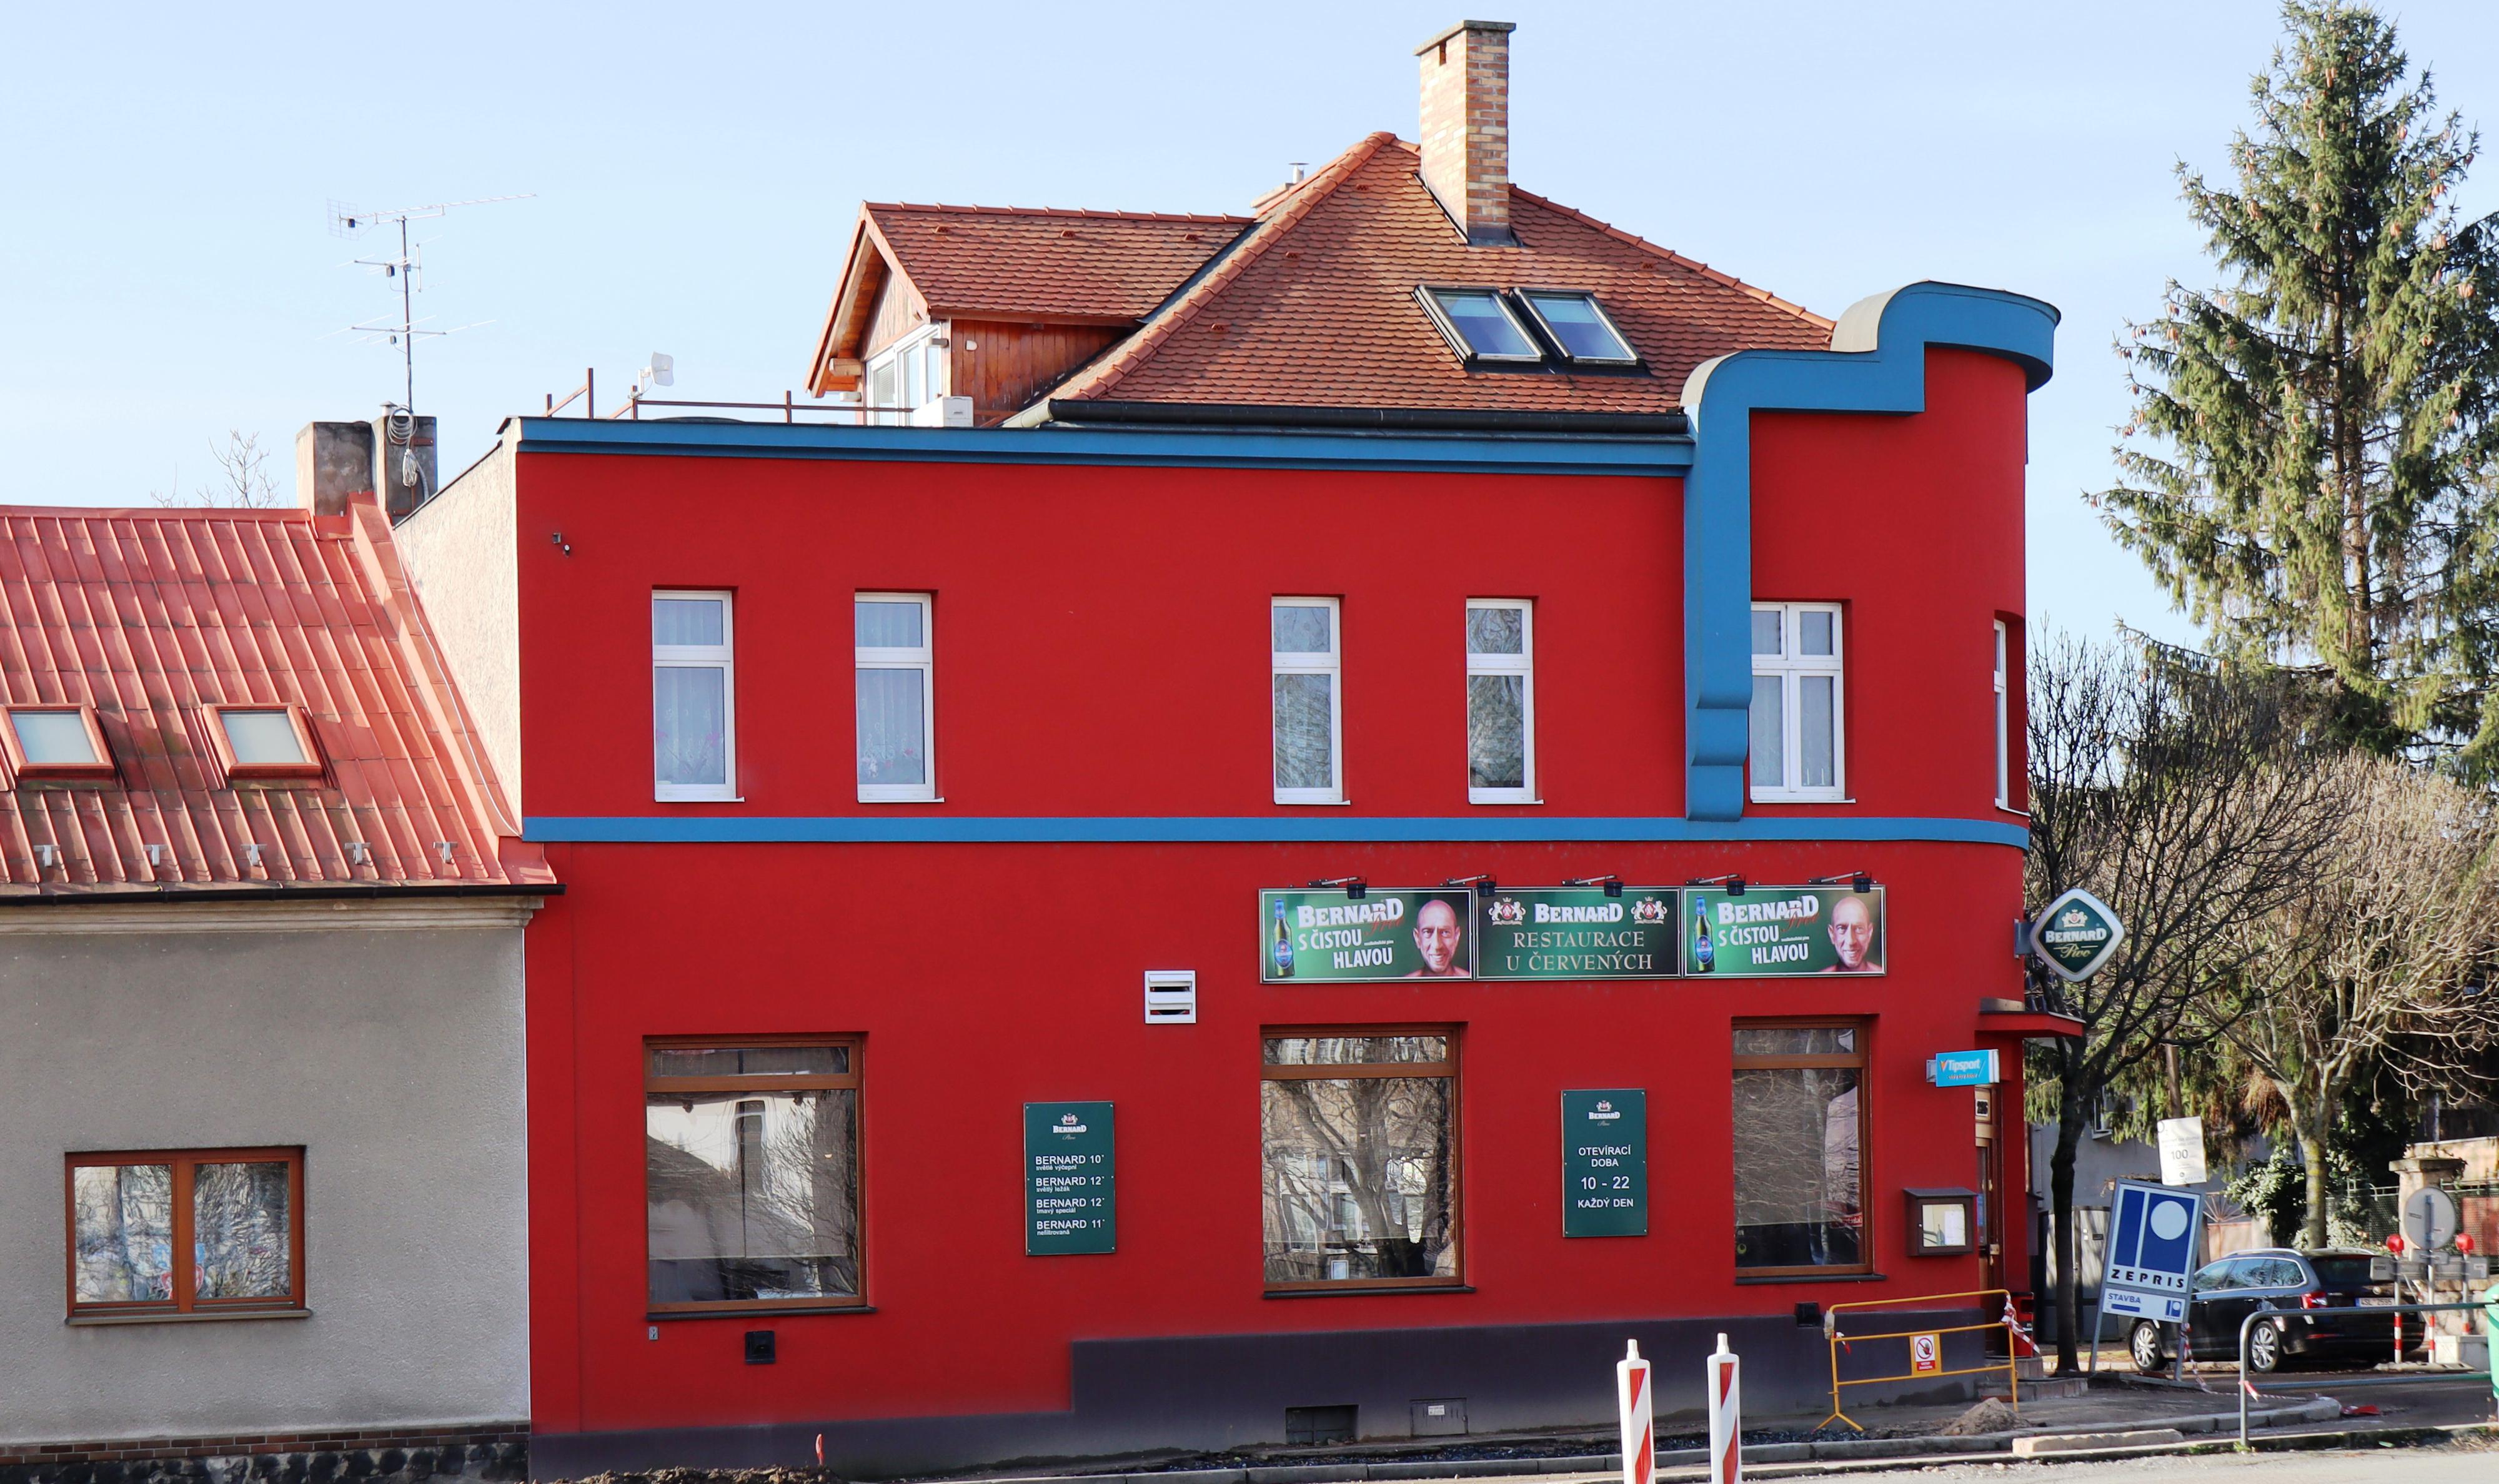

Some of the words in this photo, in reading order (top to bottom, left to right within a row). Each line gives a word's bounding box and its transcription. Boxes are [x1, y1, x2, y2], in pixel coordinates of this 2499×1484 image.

[1296, 898, 1404, 928] BERNARD
[1534, 903, 1624, 923] BERNARD
[1717, 895, 1819, 924] BERNARD
[1298, 933, 1308, 951] S
[1310, 929, 1362, 950] ČISTOU
[1513, 931, 1644, 948] RESTAURACE
[1719, 930, 1727, 947] S
[1730, 925, 1779, 946] ČISTOU
[2045, 928, 2107, 943] BERNARD
[1333, 947, 1393, 969] HLAVOU
[1751, 943, 1809, 964] HLAVOU
[2060, 943, 2090, 958] Pivo
[1506, 955, 1519, 971] U
[1529, 950, 1652, 971] ČERVENÝCH
[1949, 1059, 1980, 1073] Tipsport
[1053, 1125, 1087, 1134] BERNARD
[1578, 1144, 1631, 1156] OTEVÍRACÍ
[2171, 1149, 2188, 1160] 100
[1035, 1155, 1086, 1165] BERNARD
[1591, 1158, 1619, 1167] DOBA
[1036, 1177, 1086, 1187] BERNARD
[1581, 1177, 1597, 1190] 10
[1612, 1175, 1630, 1189] 22
[1036, 1198, 1086, 1208] BERNARD
[1577, 1197, 1610, 1209] KAŽDÝ
[1613, 1198, 1634, 1207] DEN
[1036, 1220, 1087, 1230] BERNARD
[2111, 1269, 2184, 1288] ZEPRIS
[2108, 1293, 2142, 1303] STAVBA
